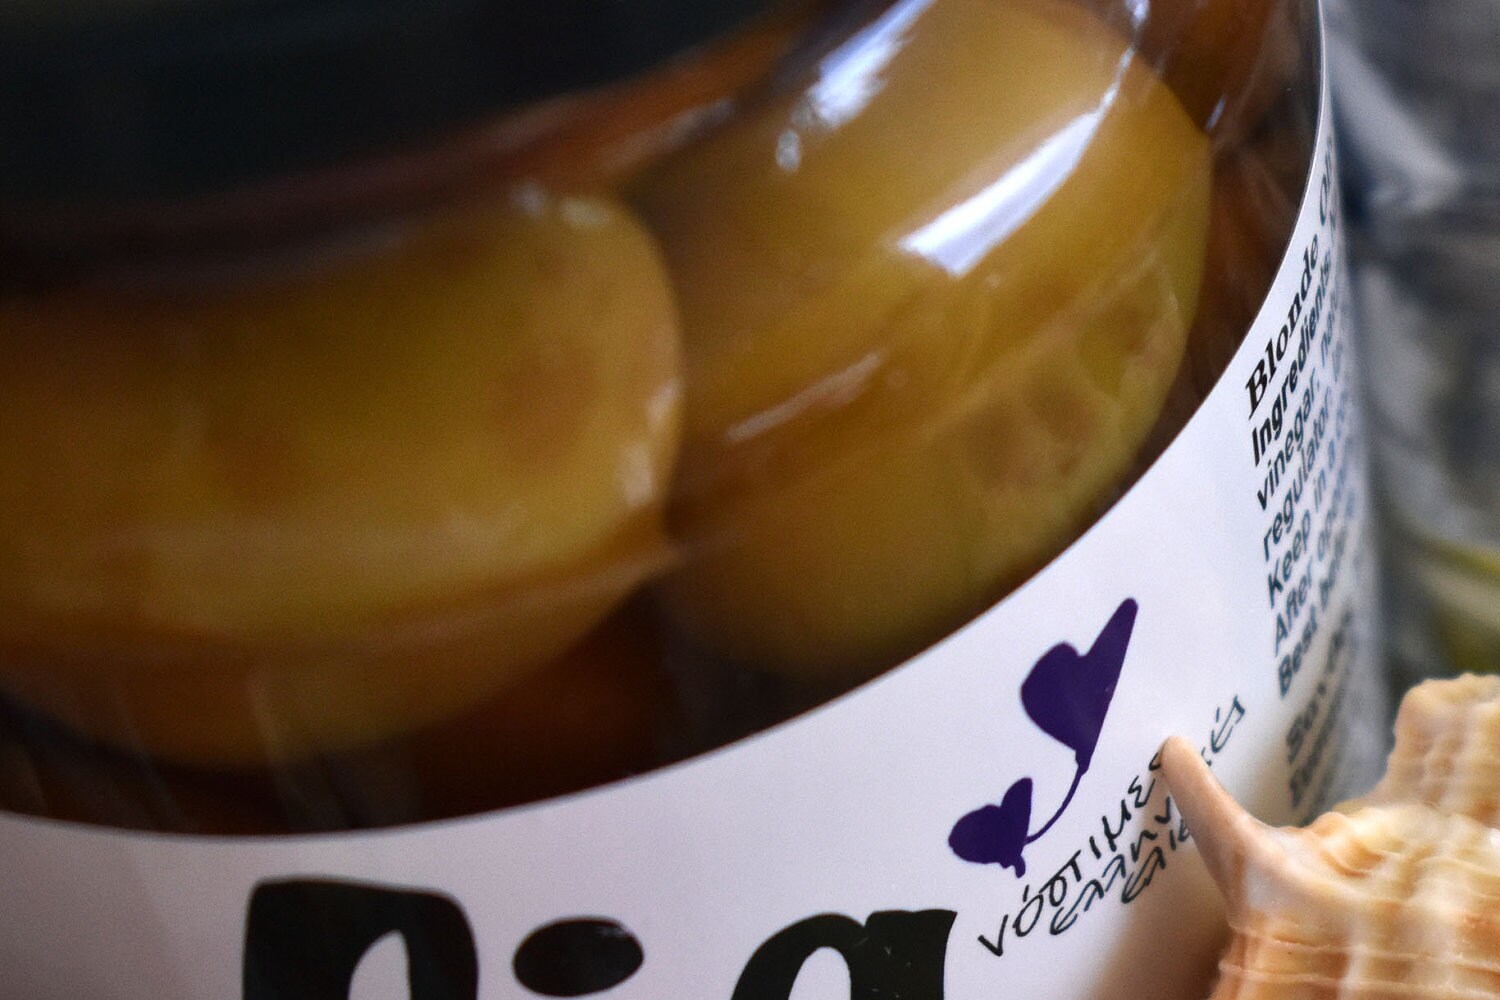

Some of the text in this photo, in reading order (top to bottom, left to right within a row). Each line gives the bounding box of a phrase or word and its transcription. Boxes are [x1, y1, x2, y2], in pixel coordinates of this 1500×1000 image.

[1245, 233, 1319, 421] Blonde
[1268, 508, 1312, 610] Keep
[1275, 555, 1313, 658] After
